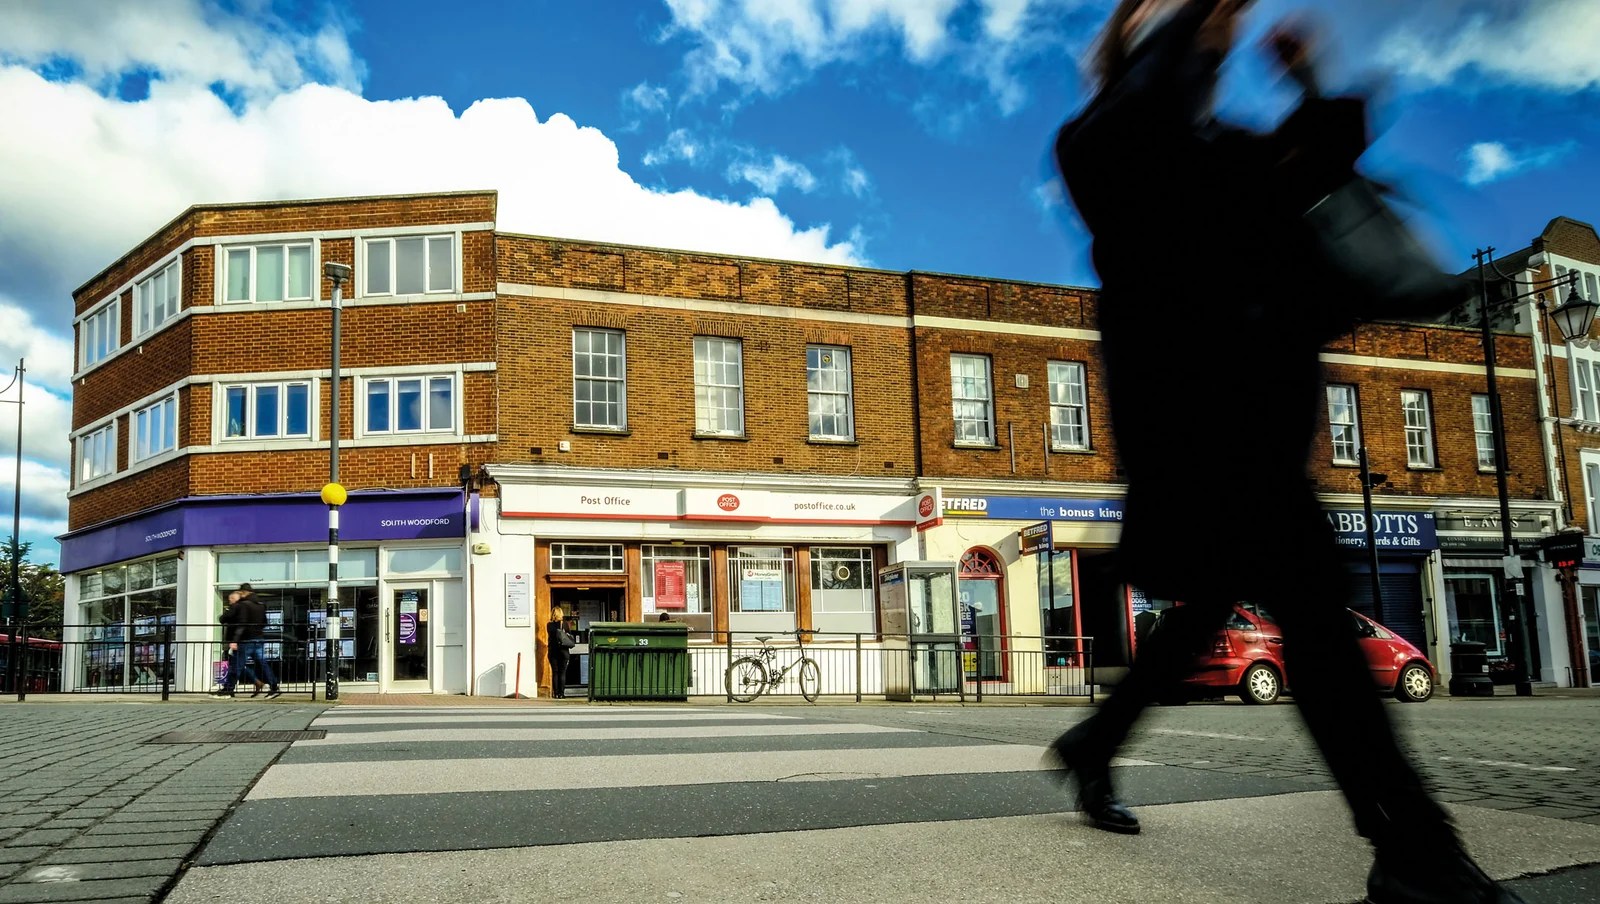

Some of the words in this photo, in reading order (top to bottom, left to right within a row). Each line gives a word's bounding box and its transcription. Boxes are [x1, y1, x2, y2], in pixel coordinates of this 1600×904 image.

[581, 496, 600, 505] Post
[604, 496, 631, 505] Office
[794, 502, 856, 511] postoffice.co.uk
[941, 498, 987, 510] ETFRED
[1040, 507, 1055, 516] the
[1060, 507, 1094, 518] bonus
[1099, 508, 1123, 520] king
[407, 518, 450, 526] WOODFORD
[1481, 516, 1519, 528] AVS
[1024, 524, 1048, 537] BETFRED
[1335, 535, 1366, 547] tionery,
[1374, 537, 1390, 546] ards
[1392, 537, 1399, 546] &
[1401, 536, 1421, 546] Gifts
